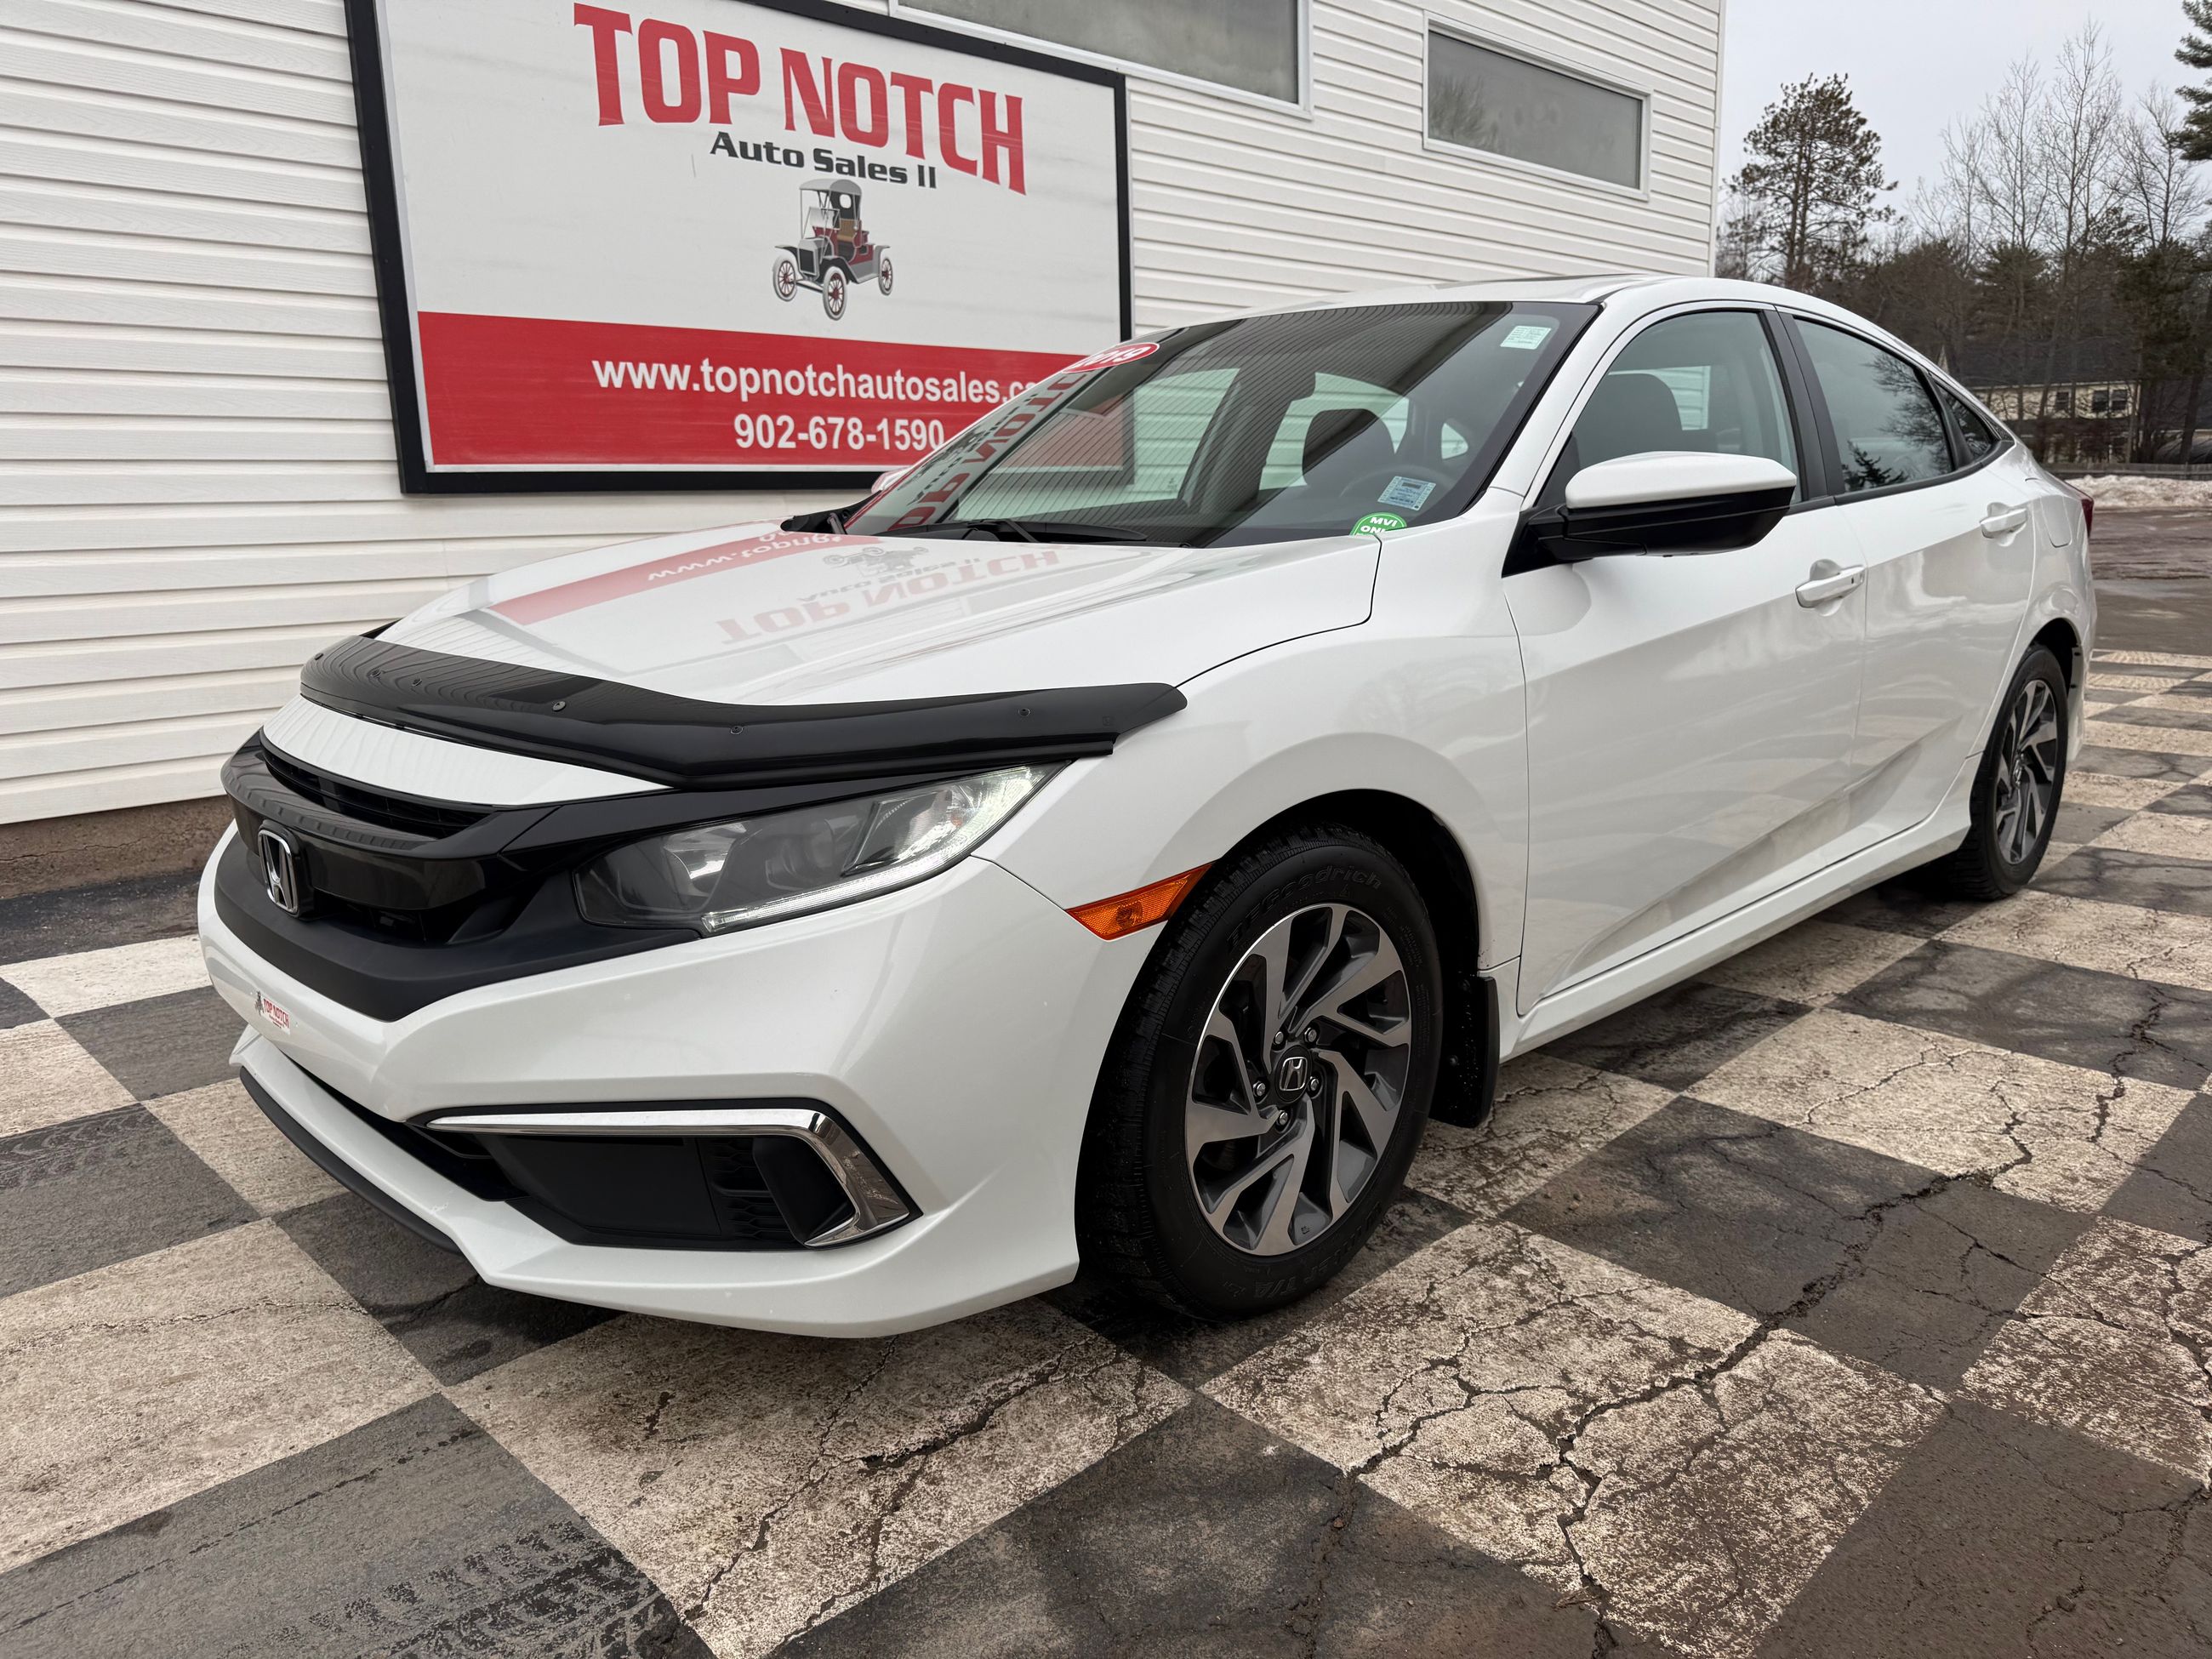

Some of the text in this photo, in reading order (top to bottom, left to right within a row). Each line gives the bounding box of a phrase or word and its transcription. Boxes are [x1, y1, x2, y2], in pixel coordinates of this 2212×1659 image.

[573, 3, 1027, 196] TOP NOTCH
[710, 131, 805, 168] Auto
[812, 147, 909, 185] Sales
[734, 413, 945, 452] 902-678-1590
[1370, 516, 1398, 527] MVI
